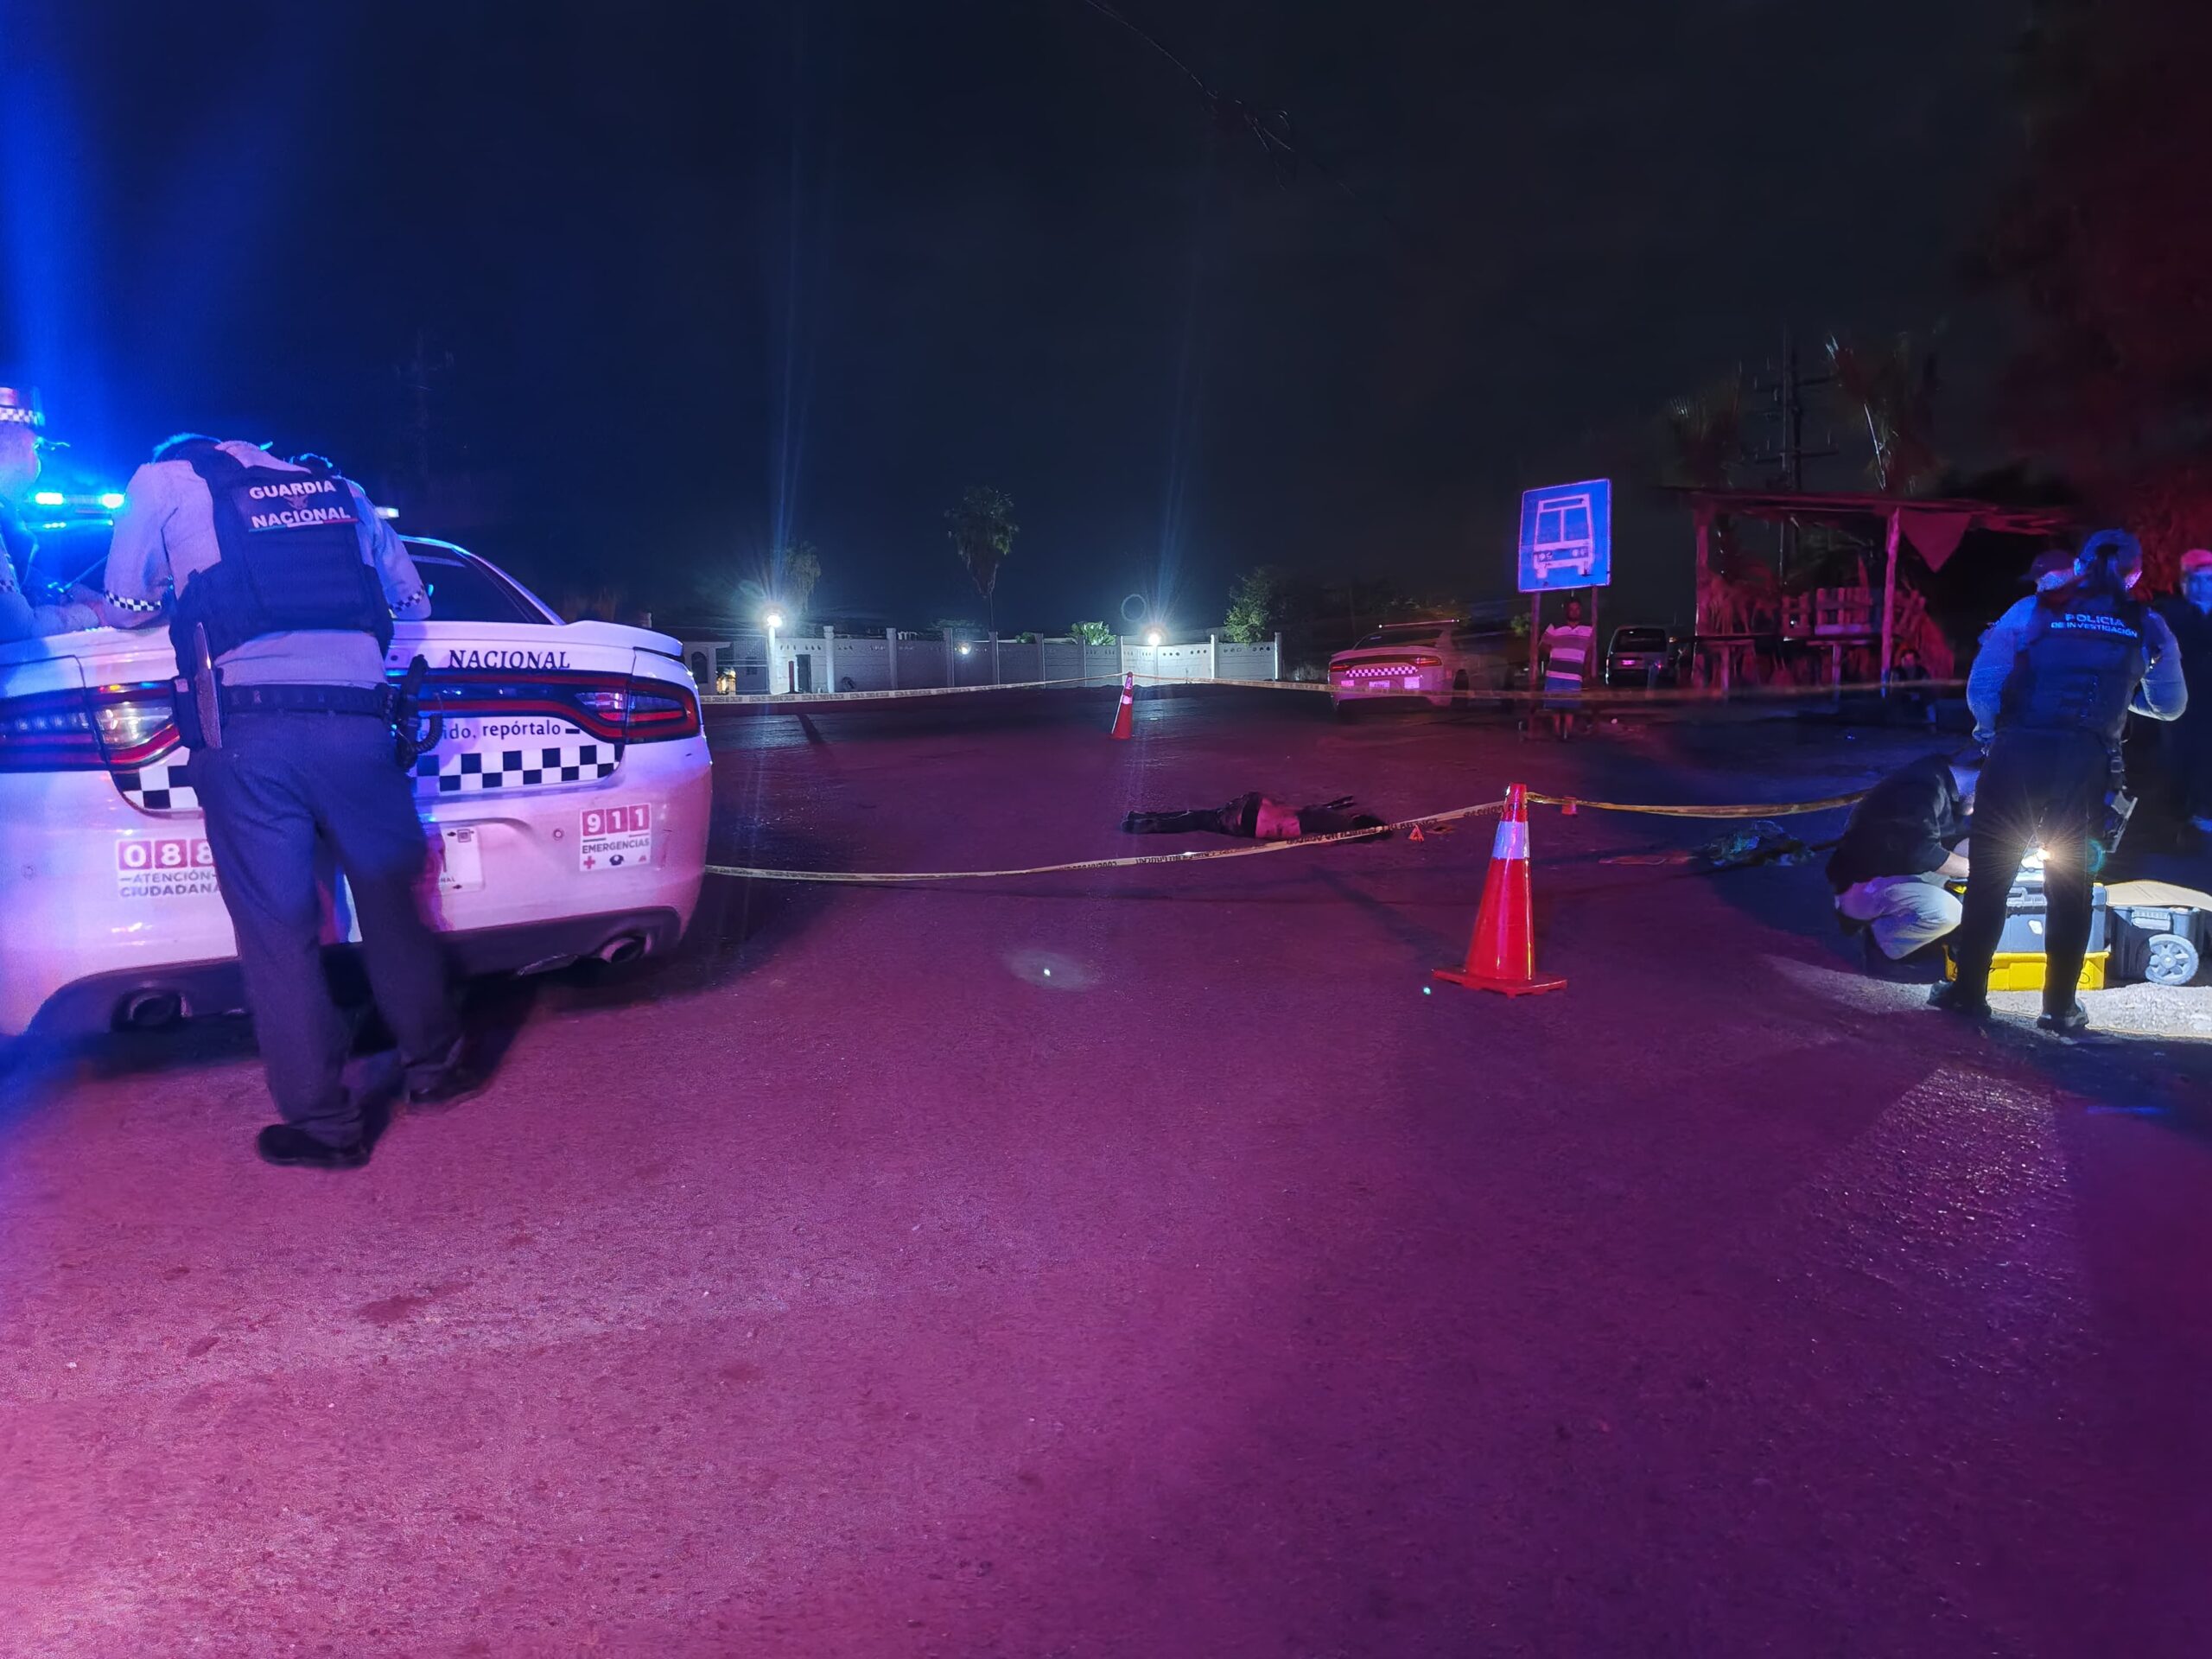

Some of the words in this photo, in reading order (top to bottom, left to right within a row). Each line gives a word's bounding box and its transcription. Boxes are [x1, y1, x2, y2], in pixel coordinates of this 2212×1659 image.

[249, 480, 337, 499] GUARDIA
[251, 506, 351, 528] NACIONAL
[448, 650, 570, 670] NACIONAL
[482, 719, 561, 740] repórtalo
[587, 808, 644, 833] 911
[582, 837, 650, 854] EMERGENCIAS
[133, 869, 211, 883] ATENCIÓN
